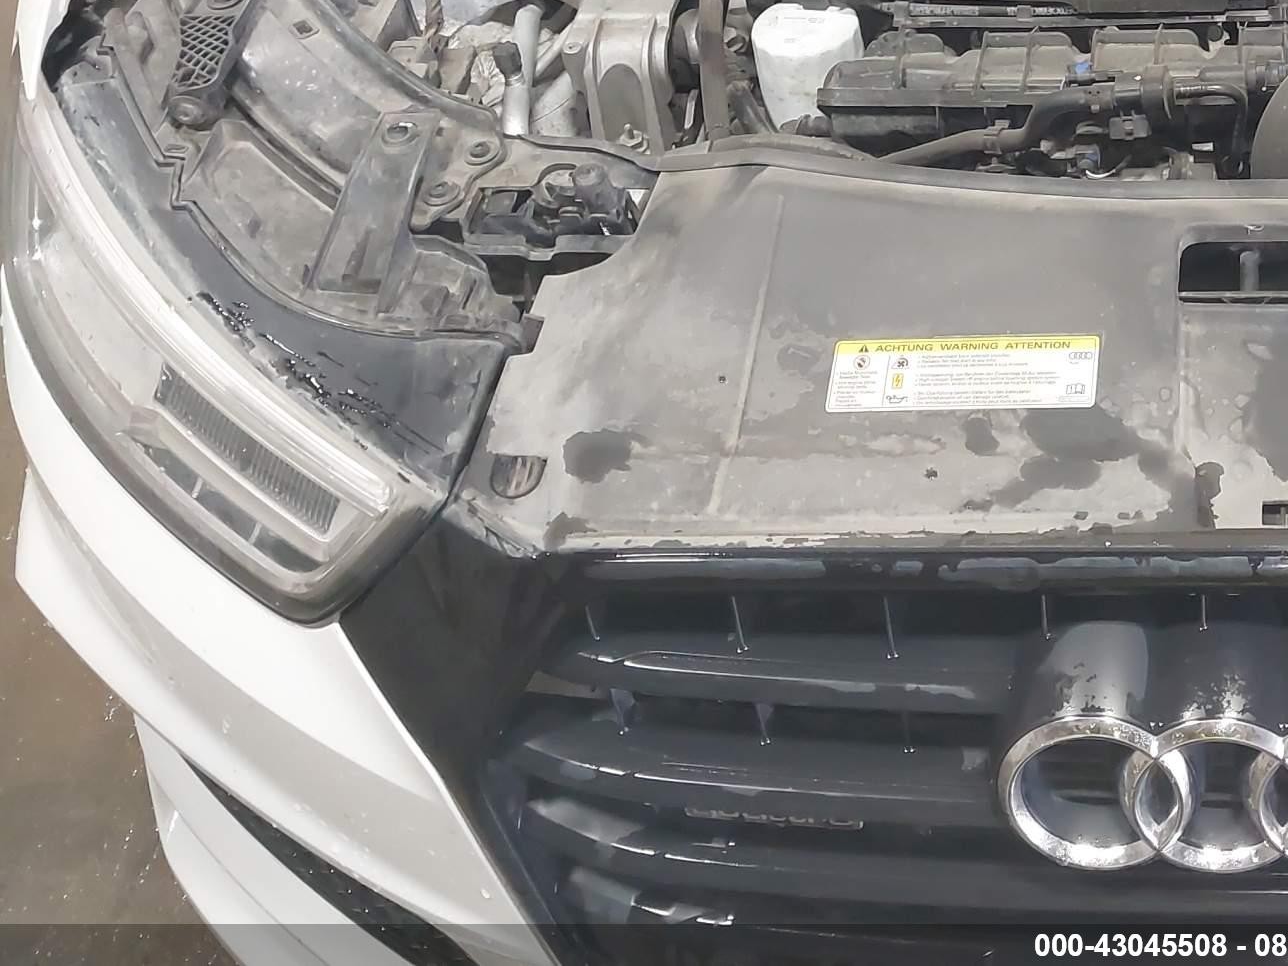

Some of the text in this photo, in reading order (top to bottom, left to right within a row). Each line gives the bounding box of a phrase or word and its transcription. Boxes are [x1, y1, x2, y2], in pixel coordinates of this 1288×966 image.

[875, 340, 1071, 353] ACHTUNG WARNING ATTENTION
